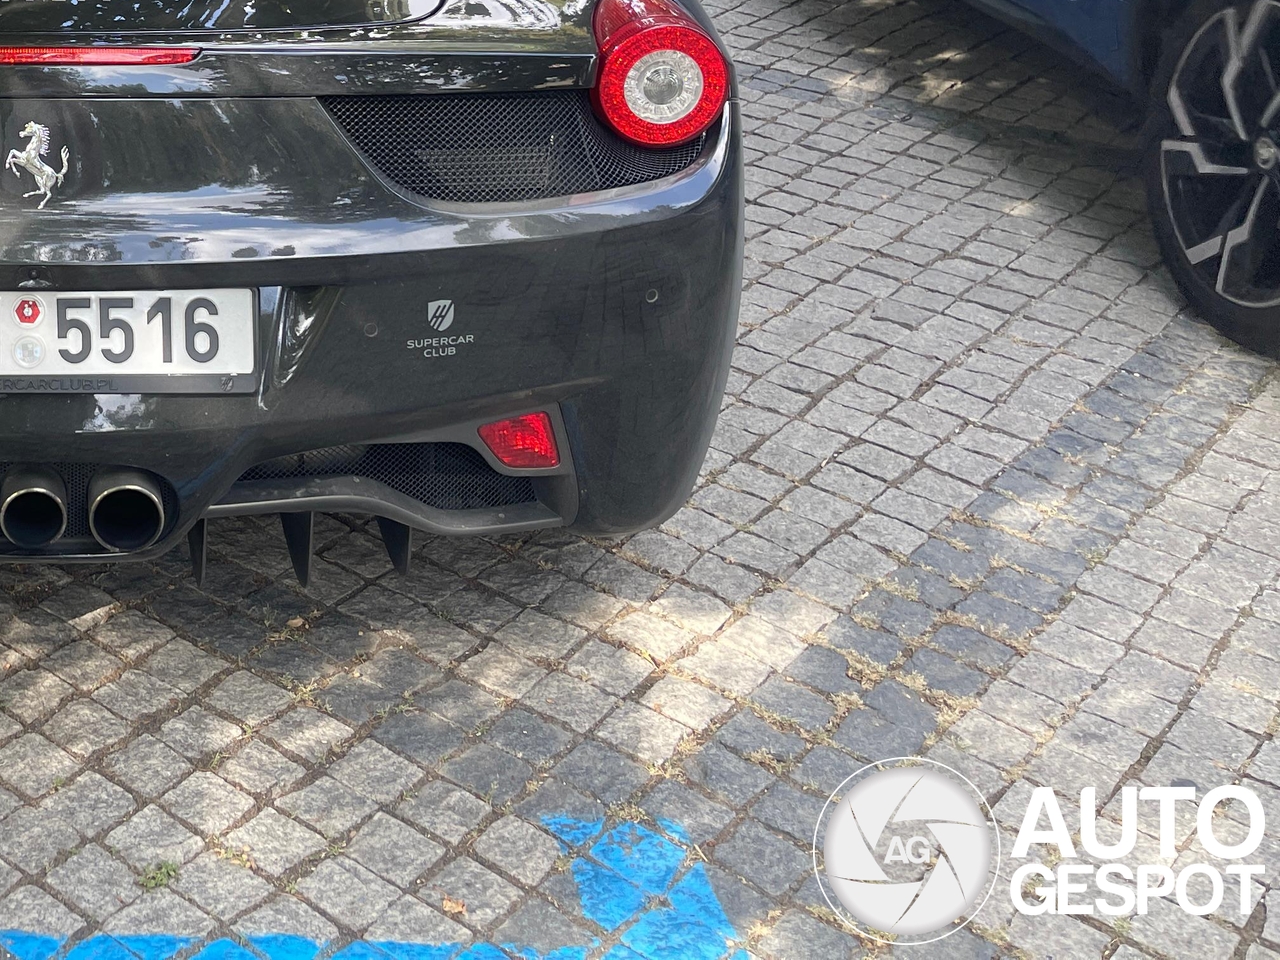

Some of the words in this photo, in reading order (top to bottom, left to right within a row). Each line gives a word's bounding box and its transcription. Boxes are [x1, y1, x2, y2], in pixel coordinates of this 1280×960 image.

[56, 297, 219, 364] 5516
[406, 334, 474, 349] SUPERCAR
[423, 346, 457, 358] CLUB
